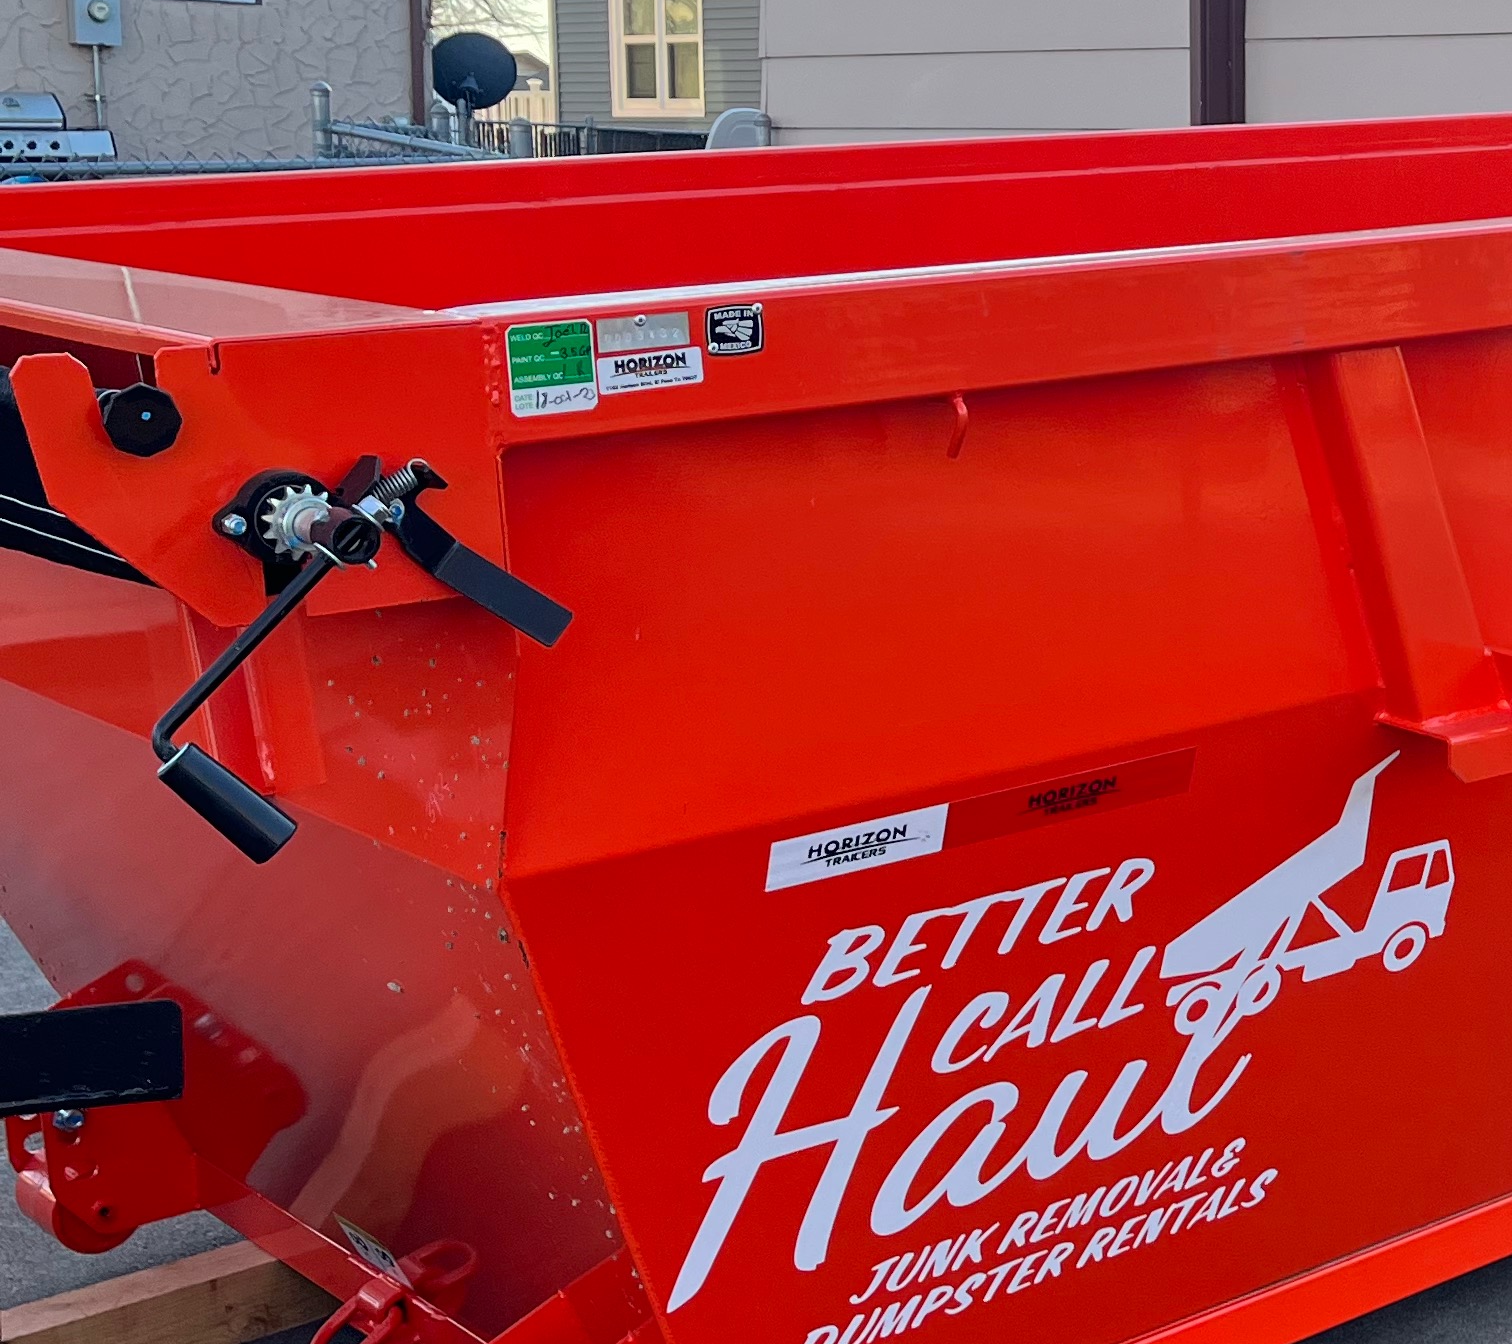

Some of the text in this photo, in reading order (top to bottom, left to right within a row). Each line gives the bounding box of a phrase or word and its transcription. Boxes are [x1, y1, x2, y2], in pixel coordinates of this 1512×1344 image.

[714, 310, 741, 320] MADE
[510, 333, 531, 342] WELD
[720, 341, 752, 350] MEXICO
[511, 356, 532, 364] PAINT
[614, 352, 687, 374] HORIZON
[514, 373, 551, 383] ASSEMBLY
[1028, 776, 1117, 808] HORIZON
[807, 824, 907, 858] HORIZON
[825, 846, 886, 867] TRAILERS
[801, 859, 1154, 1005] BETTER
[931, 946, 1156, 1073] CALL
[667, 985, 1253, 1313] Haul
[1077, 1169, 1279, 1269] RENTALS
[850, 1223, 1000, 1304] JUNK
